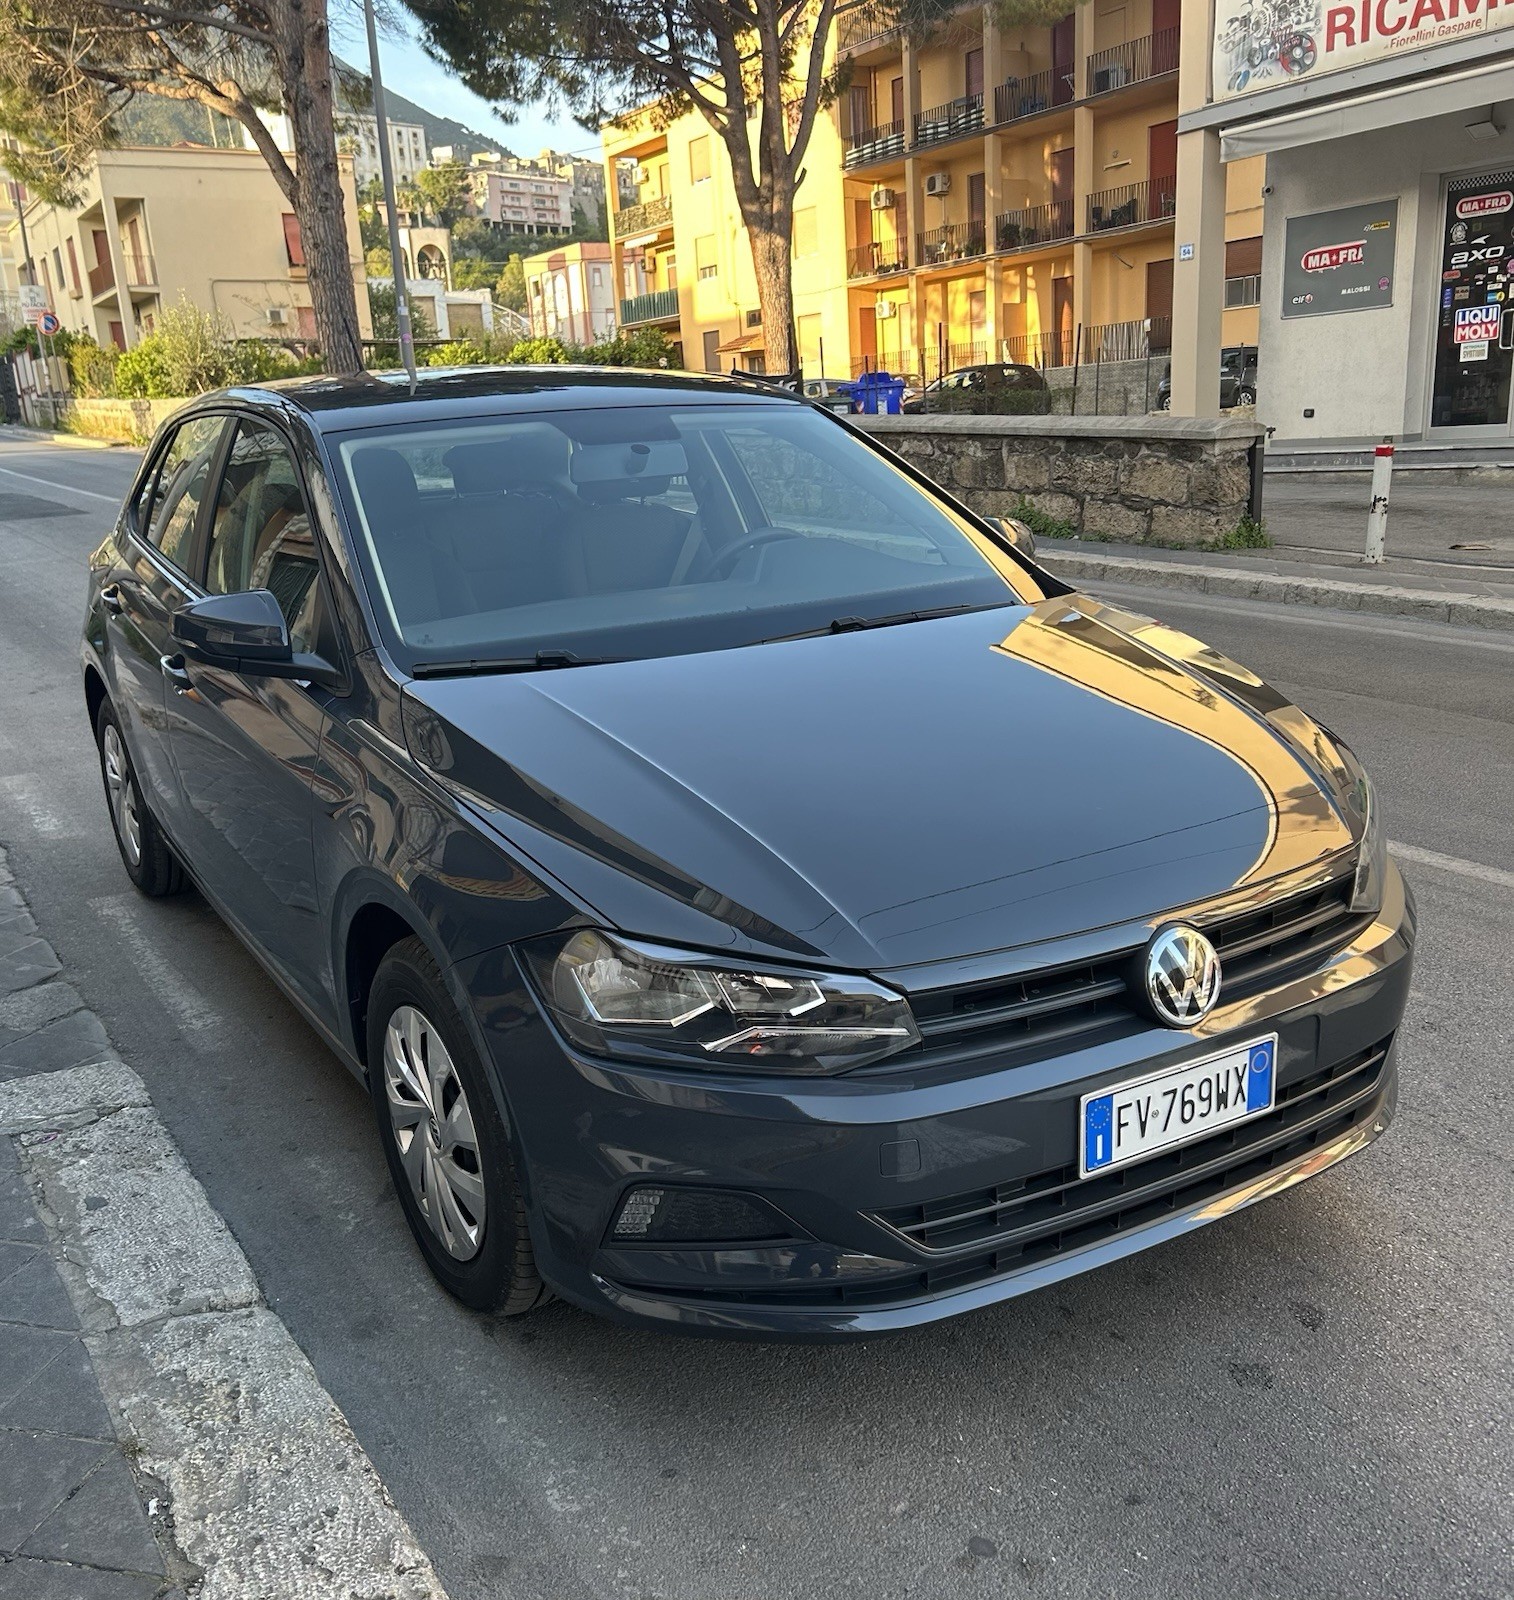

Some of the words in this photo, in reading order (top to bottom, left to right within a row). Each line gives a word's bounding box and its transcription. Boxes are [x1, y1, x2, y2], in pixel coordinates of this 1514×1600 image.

[1326, 0, 1514, 53] RICA
[1389, 26, 1435, 49] Fiorellini
[1437, 18, 1482, 37] Gaspare
[1341, 285, 1371, 295] MALOSSI
[1458, 307, 1498, 325] LIQUI
[1457, 323, 1497, 340] MOLY
